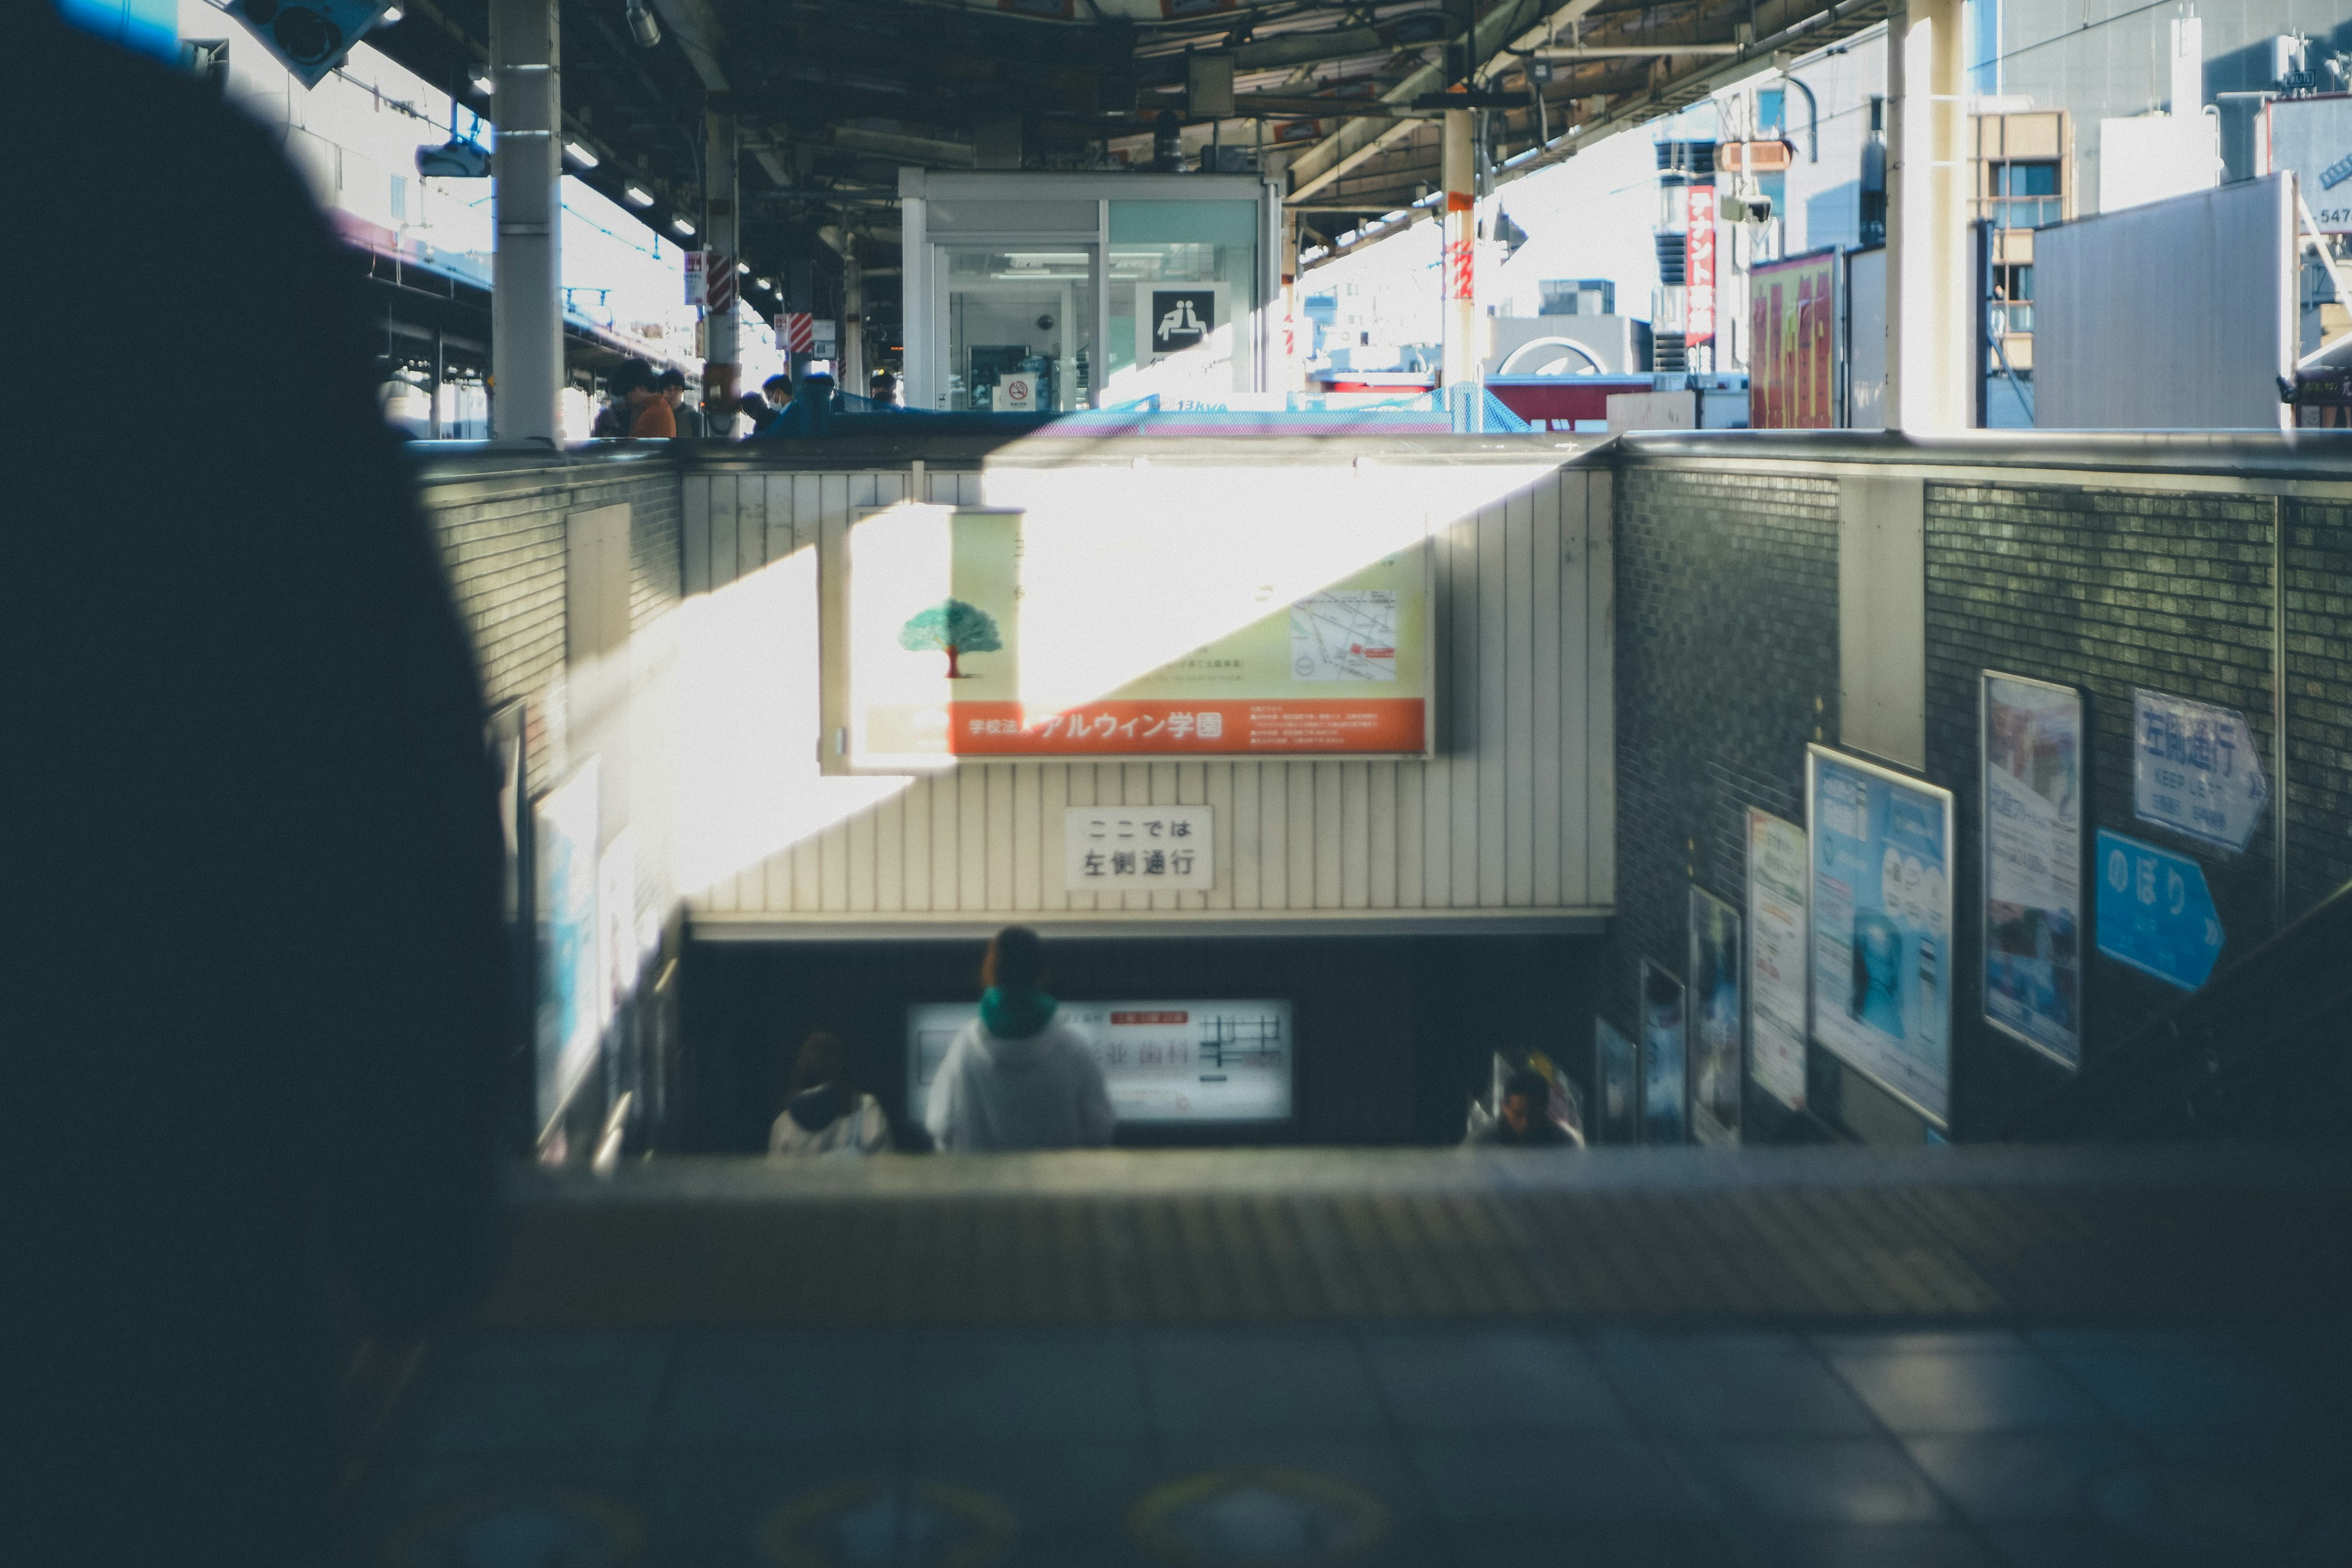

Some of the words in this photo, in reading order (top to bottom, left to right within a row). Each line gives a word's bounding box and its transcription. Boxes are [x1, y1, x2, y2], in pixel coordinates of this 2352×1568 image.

[969, 718, 1031, 734] 学校法
[1041, 712, 1223, 739] アルウィン学園
[2143, 707, 2236, 777] 左側通行
[1090, 820, 1192, 837] ここでは
[1084, 848, 1194, 876] 左側通行
[2108, 849, 2185, 915] のぼり
